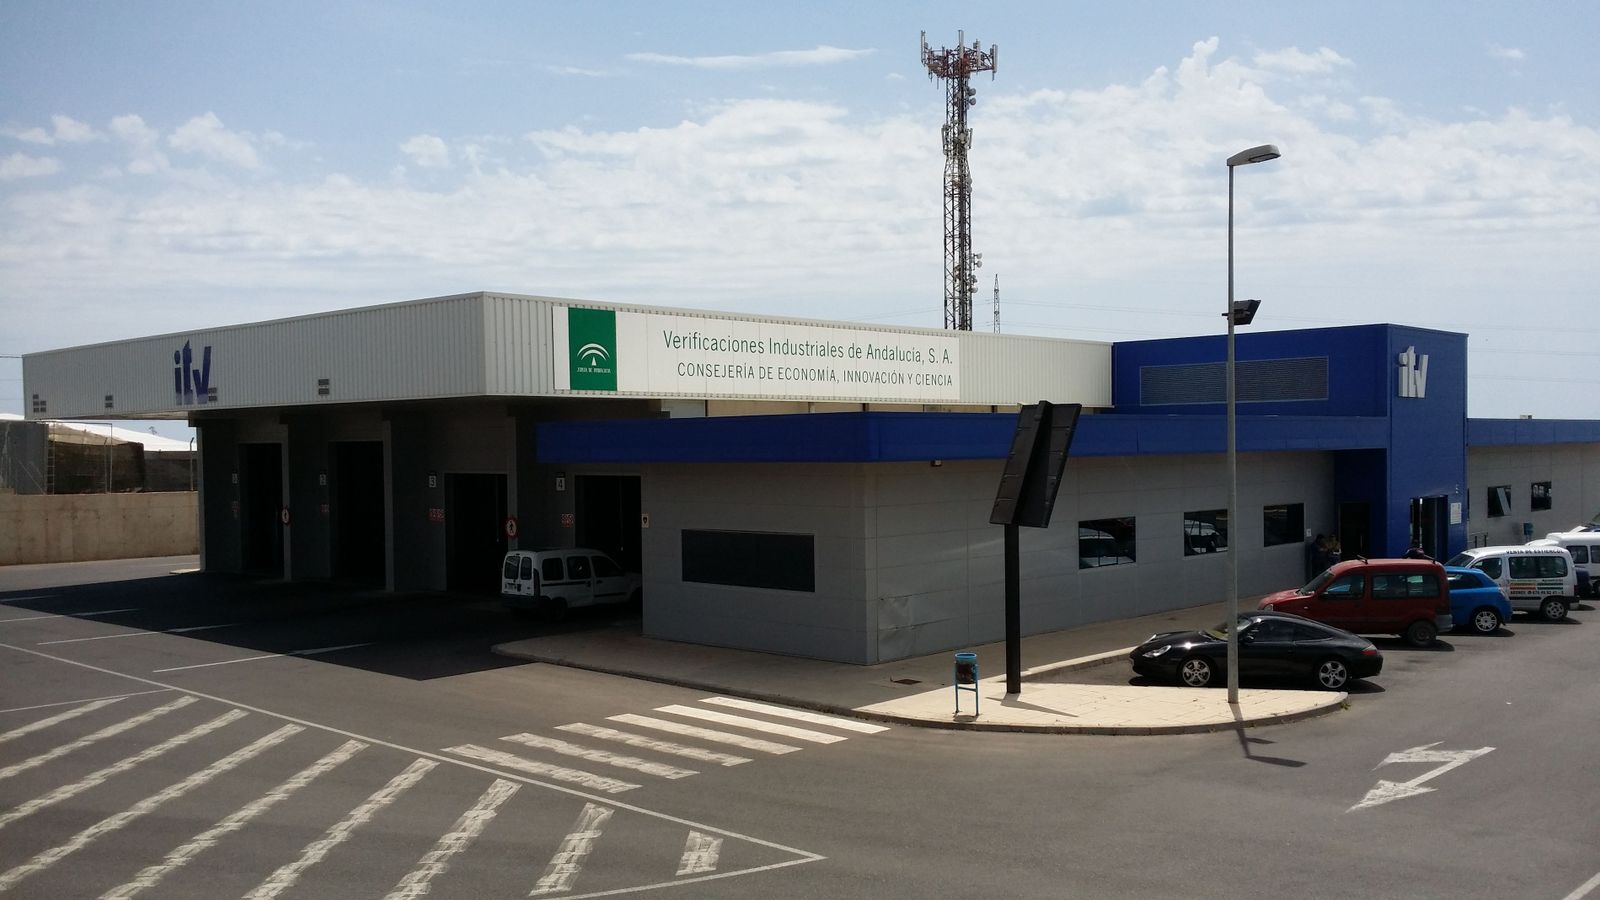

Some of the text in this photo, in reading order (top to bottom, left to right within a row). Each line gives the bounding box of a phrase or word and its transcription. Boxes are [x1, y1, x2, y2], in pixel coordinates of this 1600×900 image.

[663, 330, 953, 365] Verificaciones Industriales de Andalucía, S. A.
[677, 361, 953, 387] CONSEJERÍA DE ECONOMÍA, INNOVACIÓN Y CIENCIA
